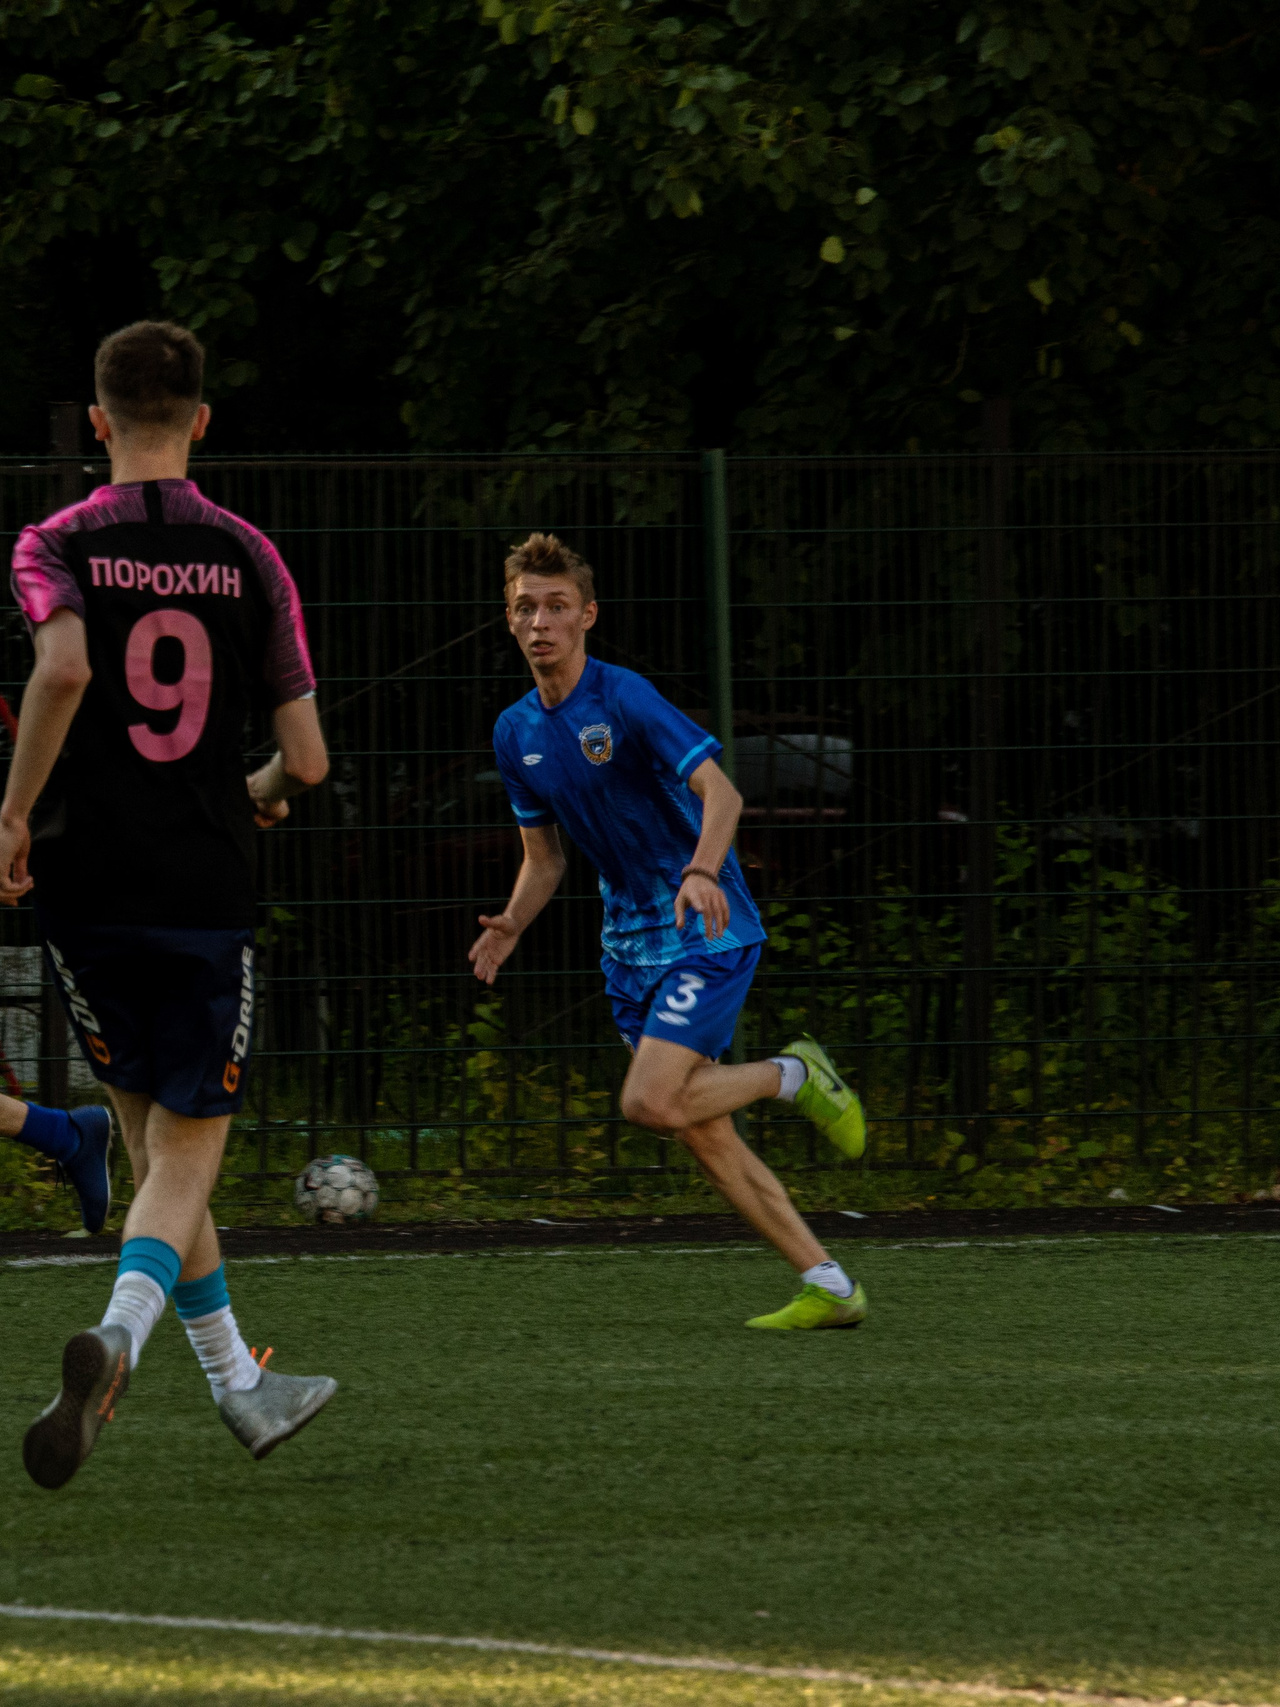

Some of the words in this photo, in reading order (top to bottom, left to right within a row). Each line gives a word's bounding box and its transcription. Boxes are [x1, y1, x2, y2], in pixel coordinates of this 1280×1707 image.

[87, 555, 242, 599] ПОРОХИН
[124, 608, 214, 763] 9
[665, 972, 706, 1012] 3
